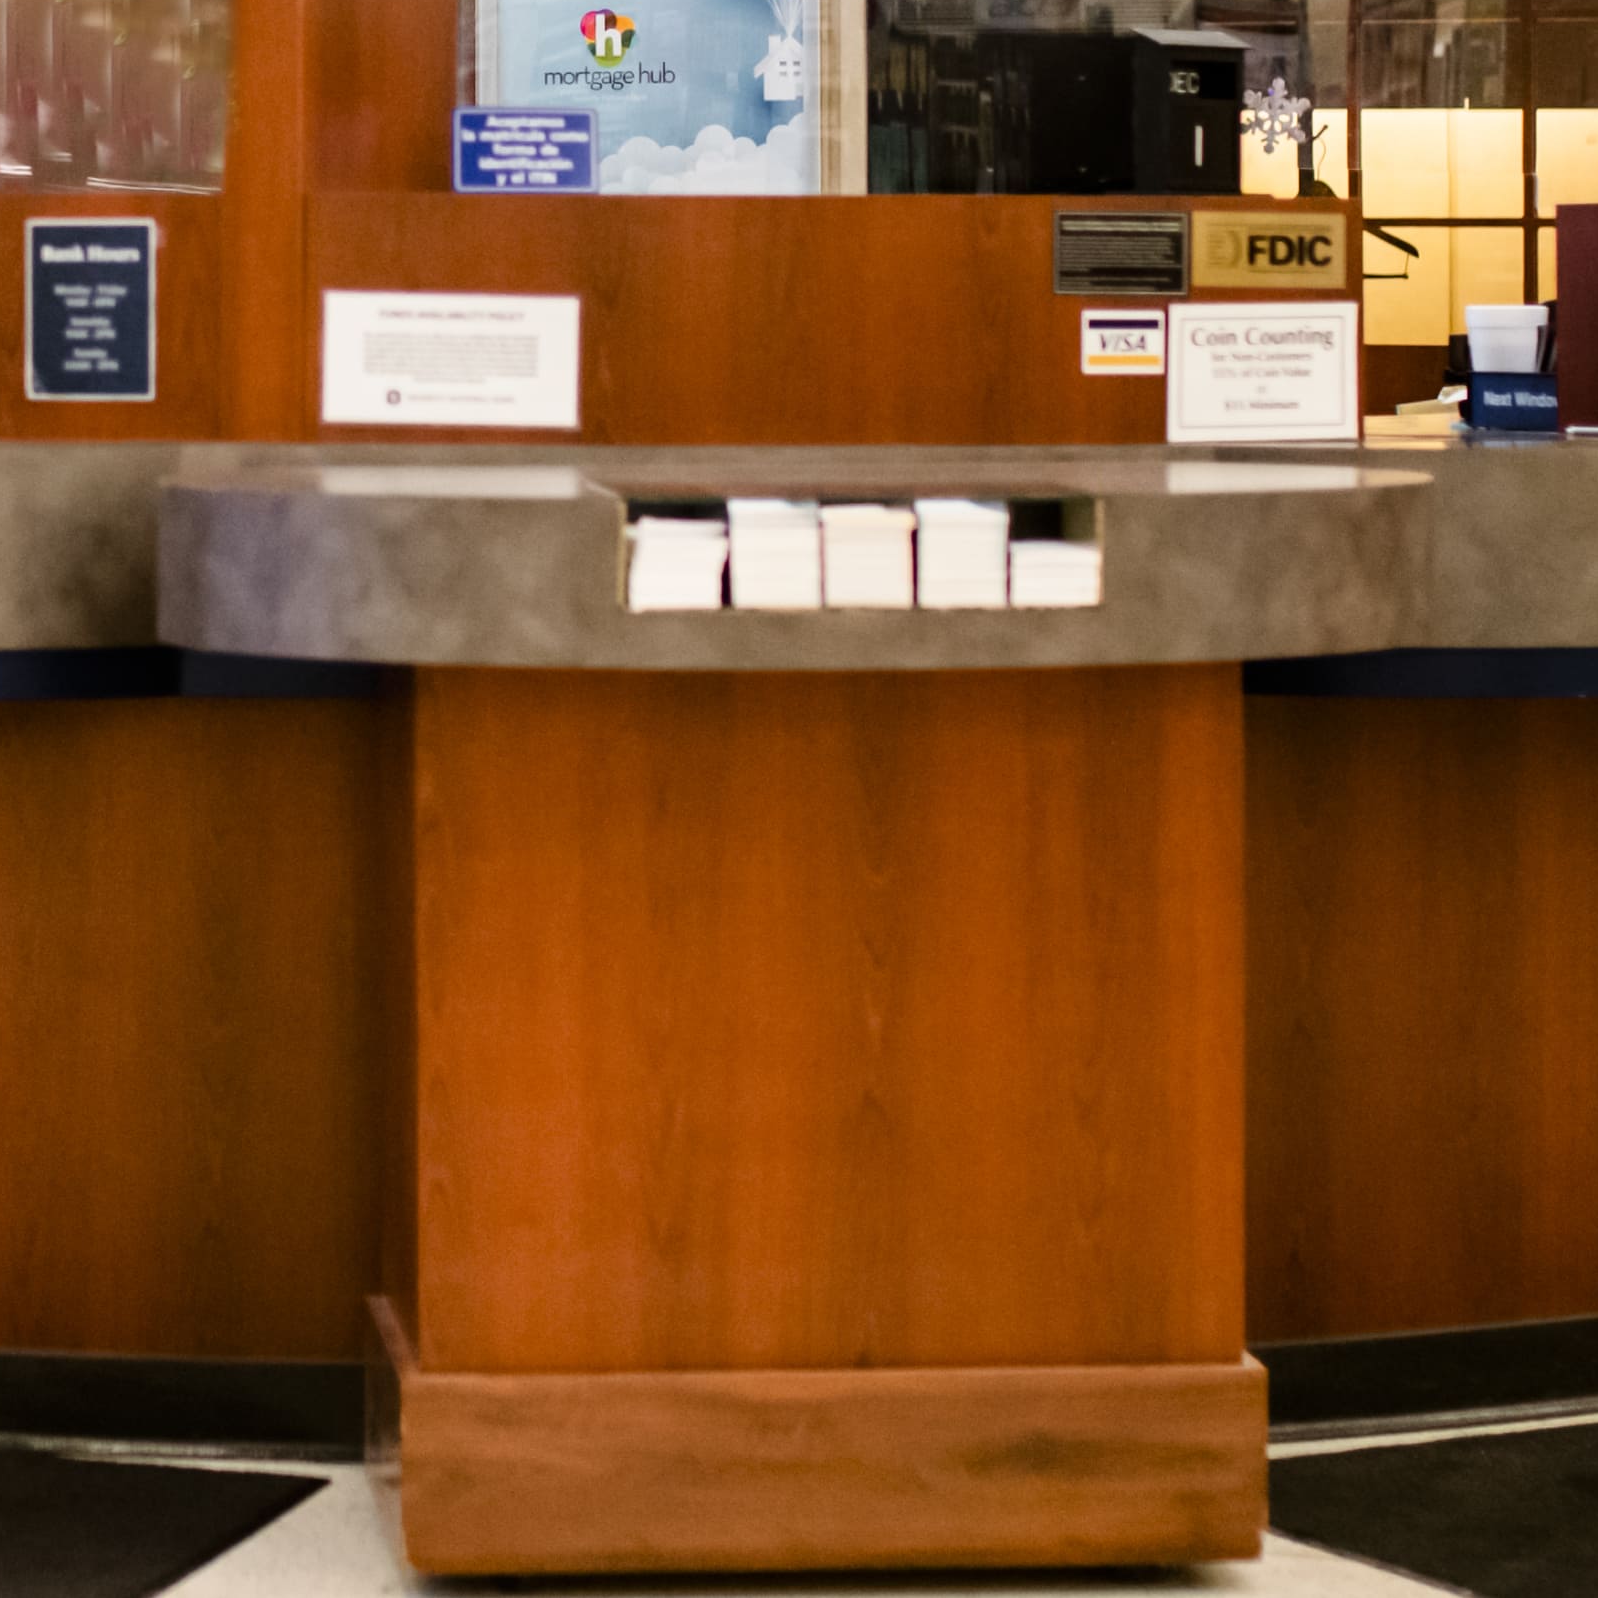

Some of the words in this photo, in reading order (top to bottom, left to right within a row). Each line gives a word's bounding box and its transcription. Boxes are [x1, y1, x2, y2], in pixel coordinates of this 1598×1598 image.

[544, 66, 635, 91] mortgage
[638, 62, 676, 84] hub
[39, 244, 85, 263] Bank
[87, 244, 141, 263] Hours
[1246, 234, 1333, 267] FDIC
[1099, 332, 1148, 352] VISA
[1190, 326, 1238, 348] Coin
[1244, 325, 1335, 351] Counting
[1483, 390, 1512, 407] Next
